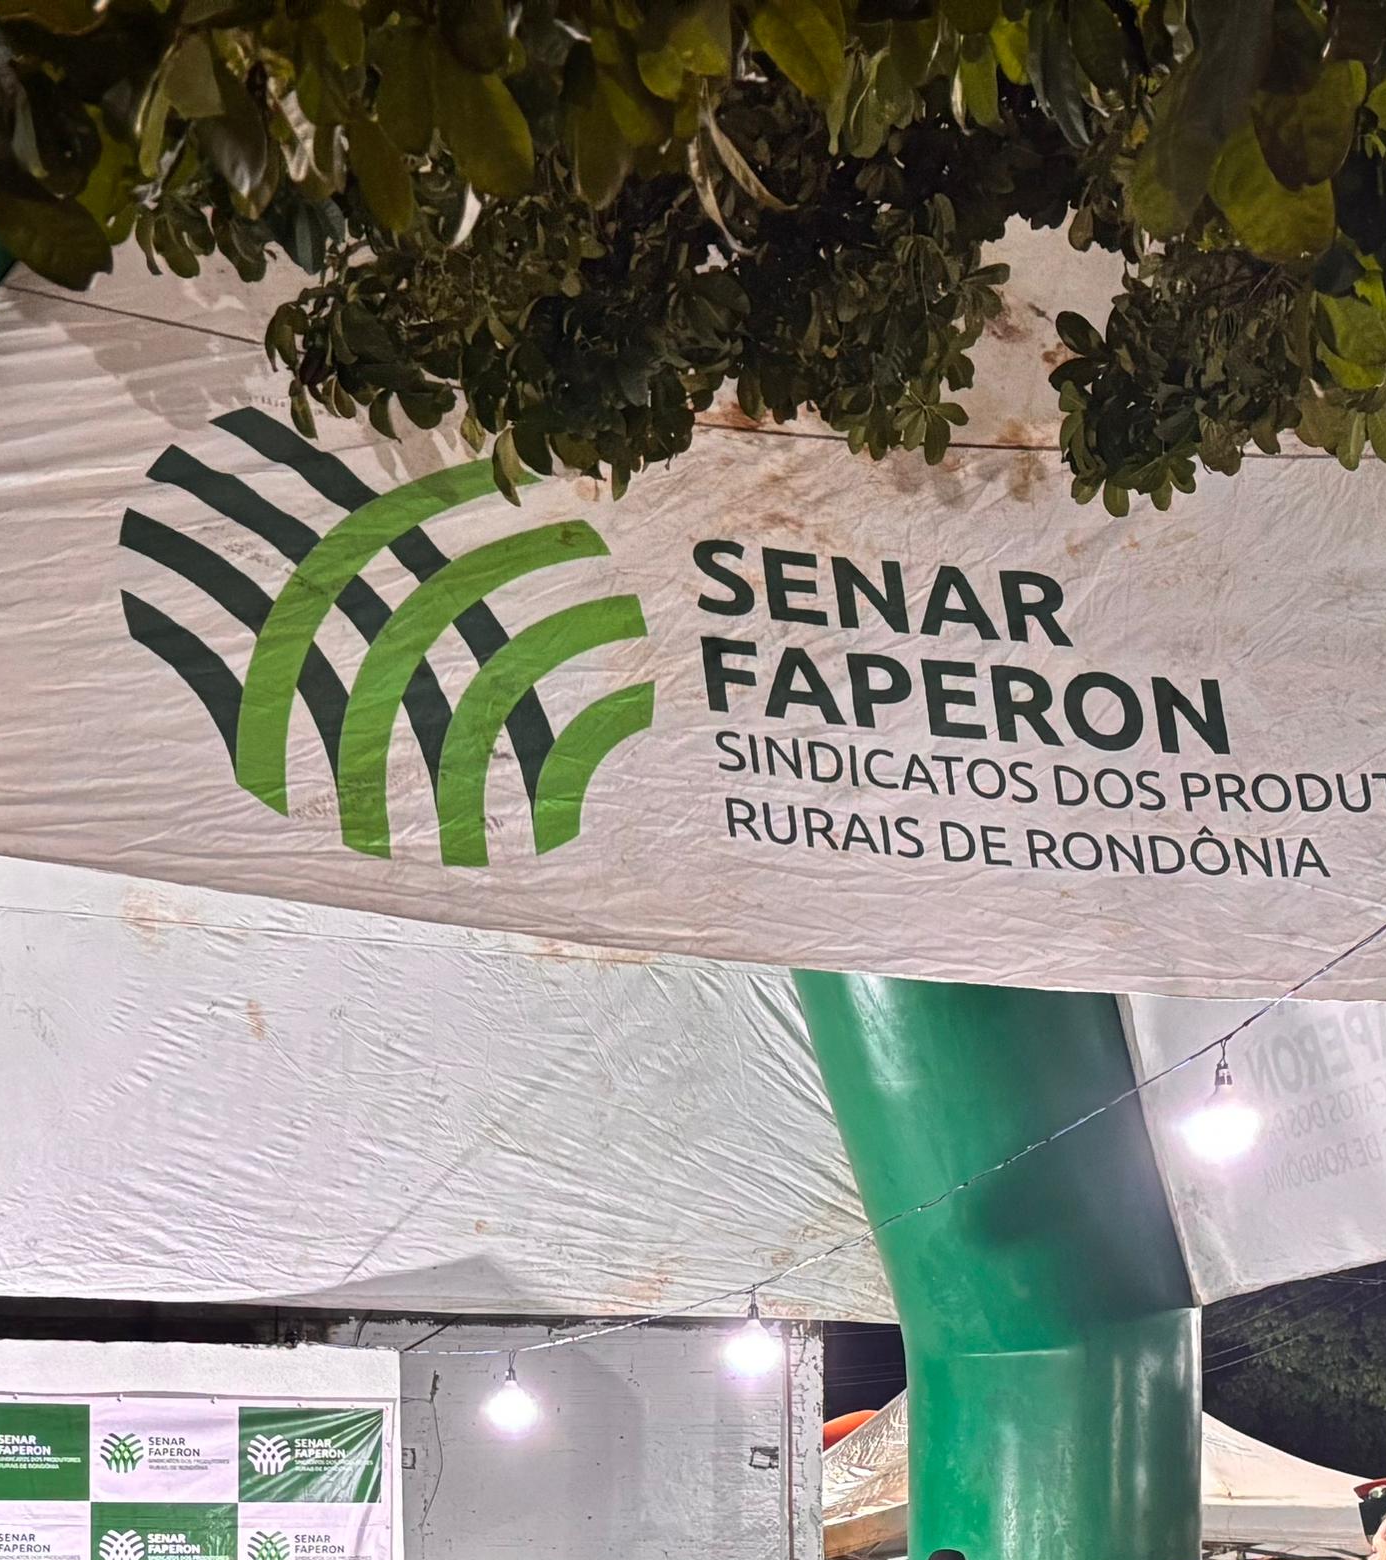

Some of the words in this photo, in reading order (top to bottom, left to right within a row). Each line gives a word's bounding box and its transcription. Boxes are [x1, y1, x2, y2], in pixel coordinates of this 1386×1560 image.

[693, 539, 1073, 647] SENAR
[700, 636, 1230, 755] FAPERON
[716, 730, 1039, 804] SINDICATOS
[1055, 766, 1164, 812] DOS
[726, 797, 924, 862] RURAIS
[941, 821, 1012, 866] DE
[1027, 826, 1330, 878] RONDÔNIA
[148, 1437, 185, 1446] SENAR
[294, 1438, 332, 1448] SENAR
[148, 1448, 200, 1457] FAPERON
[294, 1449, 346, 1458] FAPERON
[147, 1533, 186, 1543] SENAR
[294, 1534, 331, 1543] SENAR
[148, 1544, 200, 1554] FAPERON
[294, 1545, 345, 1554] FAPERON
